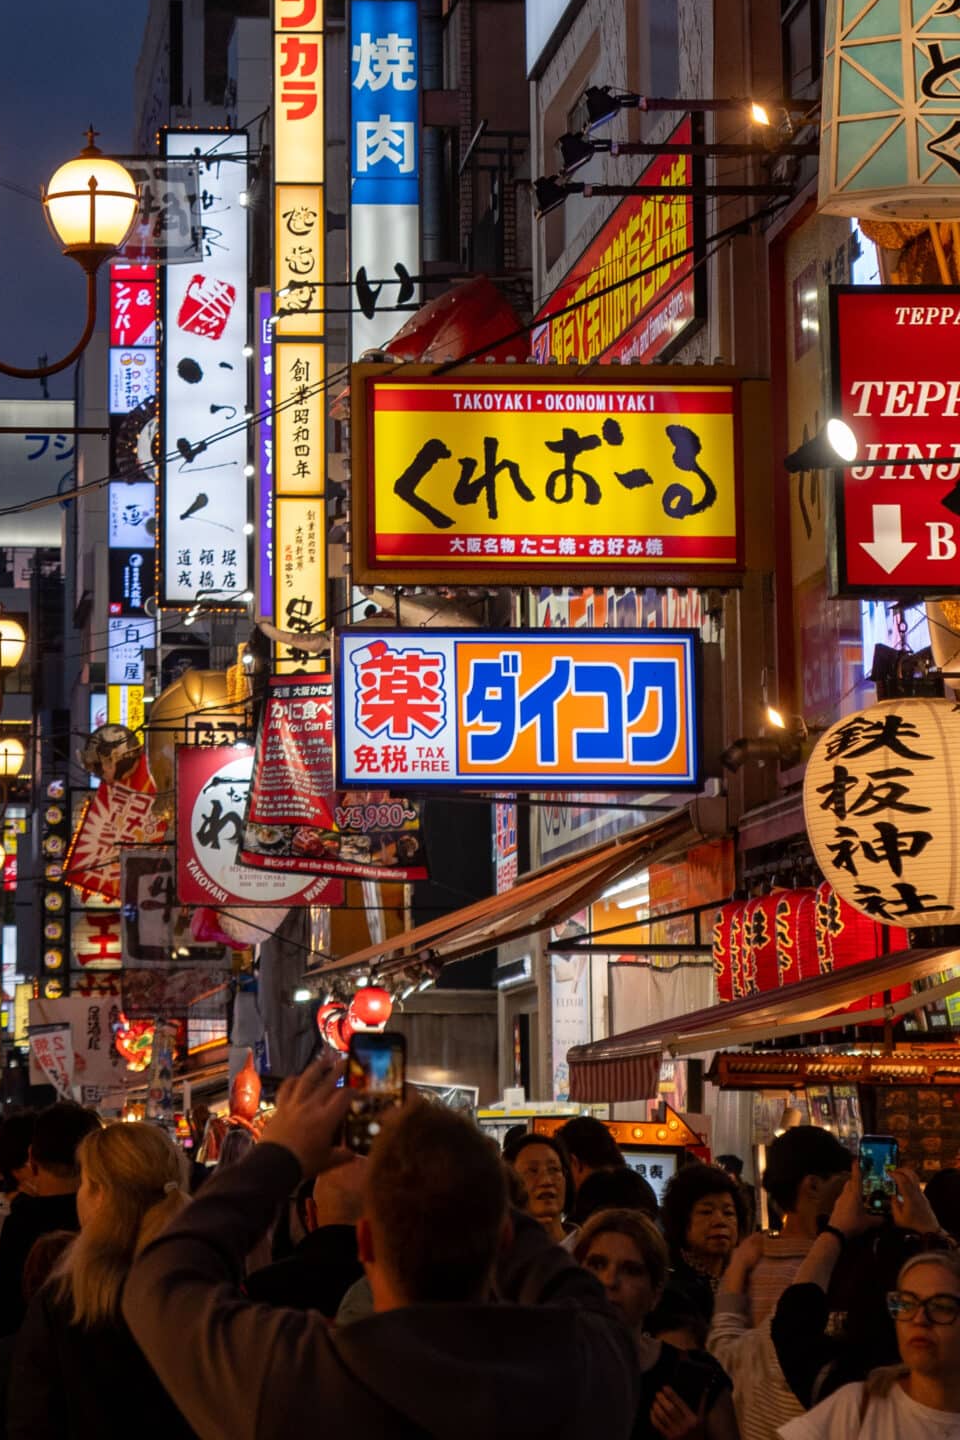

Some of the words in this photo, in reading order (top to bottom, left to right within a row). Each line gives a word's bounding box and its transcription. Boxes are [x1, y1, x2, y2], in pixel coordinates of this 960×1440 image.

[352, 32, 417, 174] 焼肉
[289, 357, 312, 479] 創業昭和四年
[393, 417, 718, 529] くれおーる
[177, 549, 238, 566] 道頓堀
[450, 537, 516, 553] 大阪名物
[357, 650, 443, 736] 薬
[464, 652, 680, 764] ダイコク
[304, 721, 323, 731] Can
[354, 745, 408, 773] 免税
[412, 760, 450, 771] FREE
[416, 747, 445, 758] TAX
[816, 714, 955, 921] 鉄板神社
[185, 858, 229, 903] TAKOYAKI
